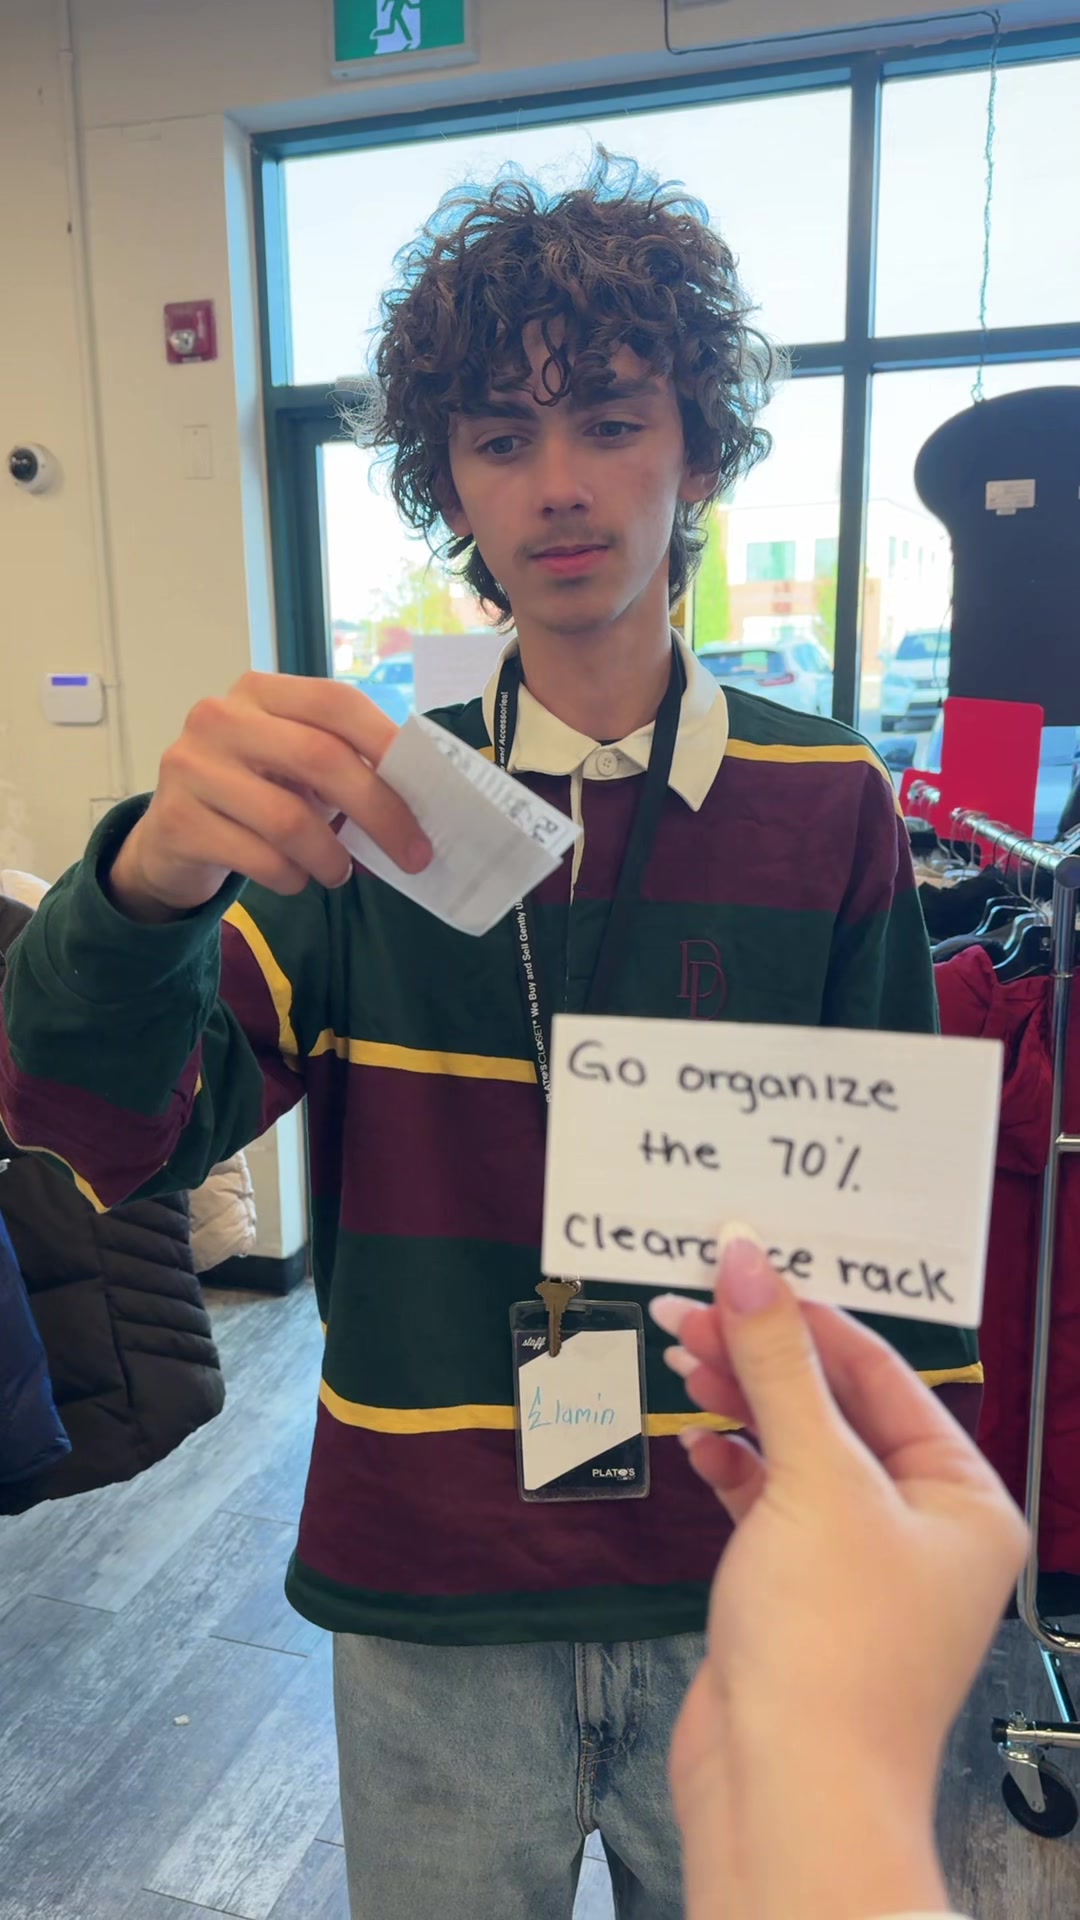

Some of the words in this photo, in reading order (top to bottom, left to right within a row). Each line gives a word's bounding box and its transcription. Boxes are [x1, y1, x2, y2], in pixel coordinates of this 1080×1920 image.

[499, 691, 508, 746] Accessories!
[516, 911, 528, 941] Gently
[520, 943, 531, 961] Sell
[523, 962, 534, 980] and
[528, 982, 537, 1001] Buy
[530, 1002, 539, 1018] We
[568, 1040, 647, 1086] Go
[678, 1064, 899, 1114] organize
[639, 1130, 721, 1170] the
[769, 1136, 861, 1192] 70%
[837, 1258, 955, 1303] rack
[521, 1336, 546, 1350] staff
